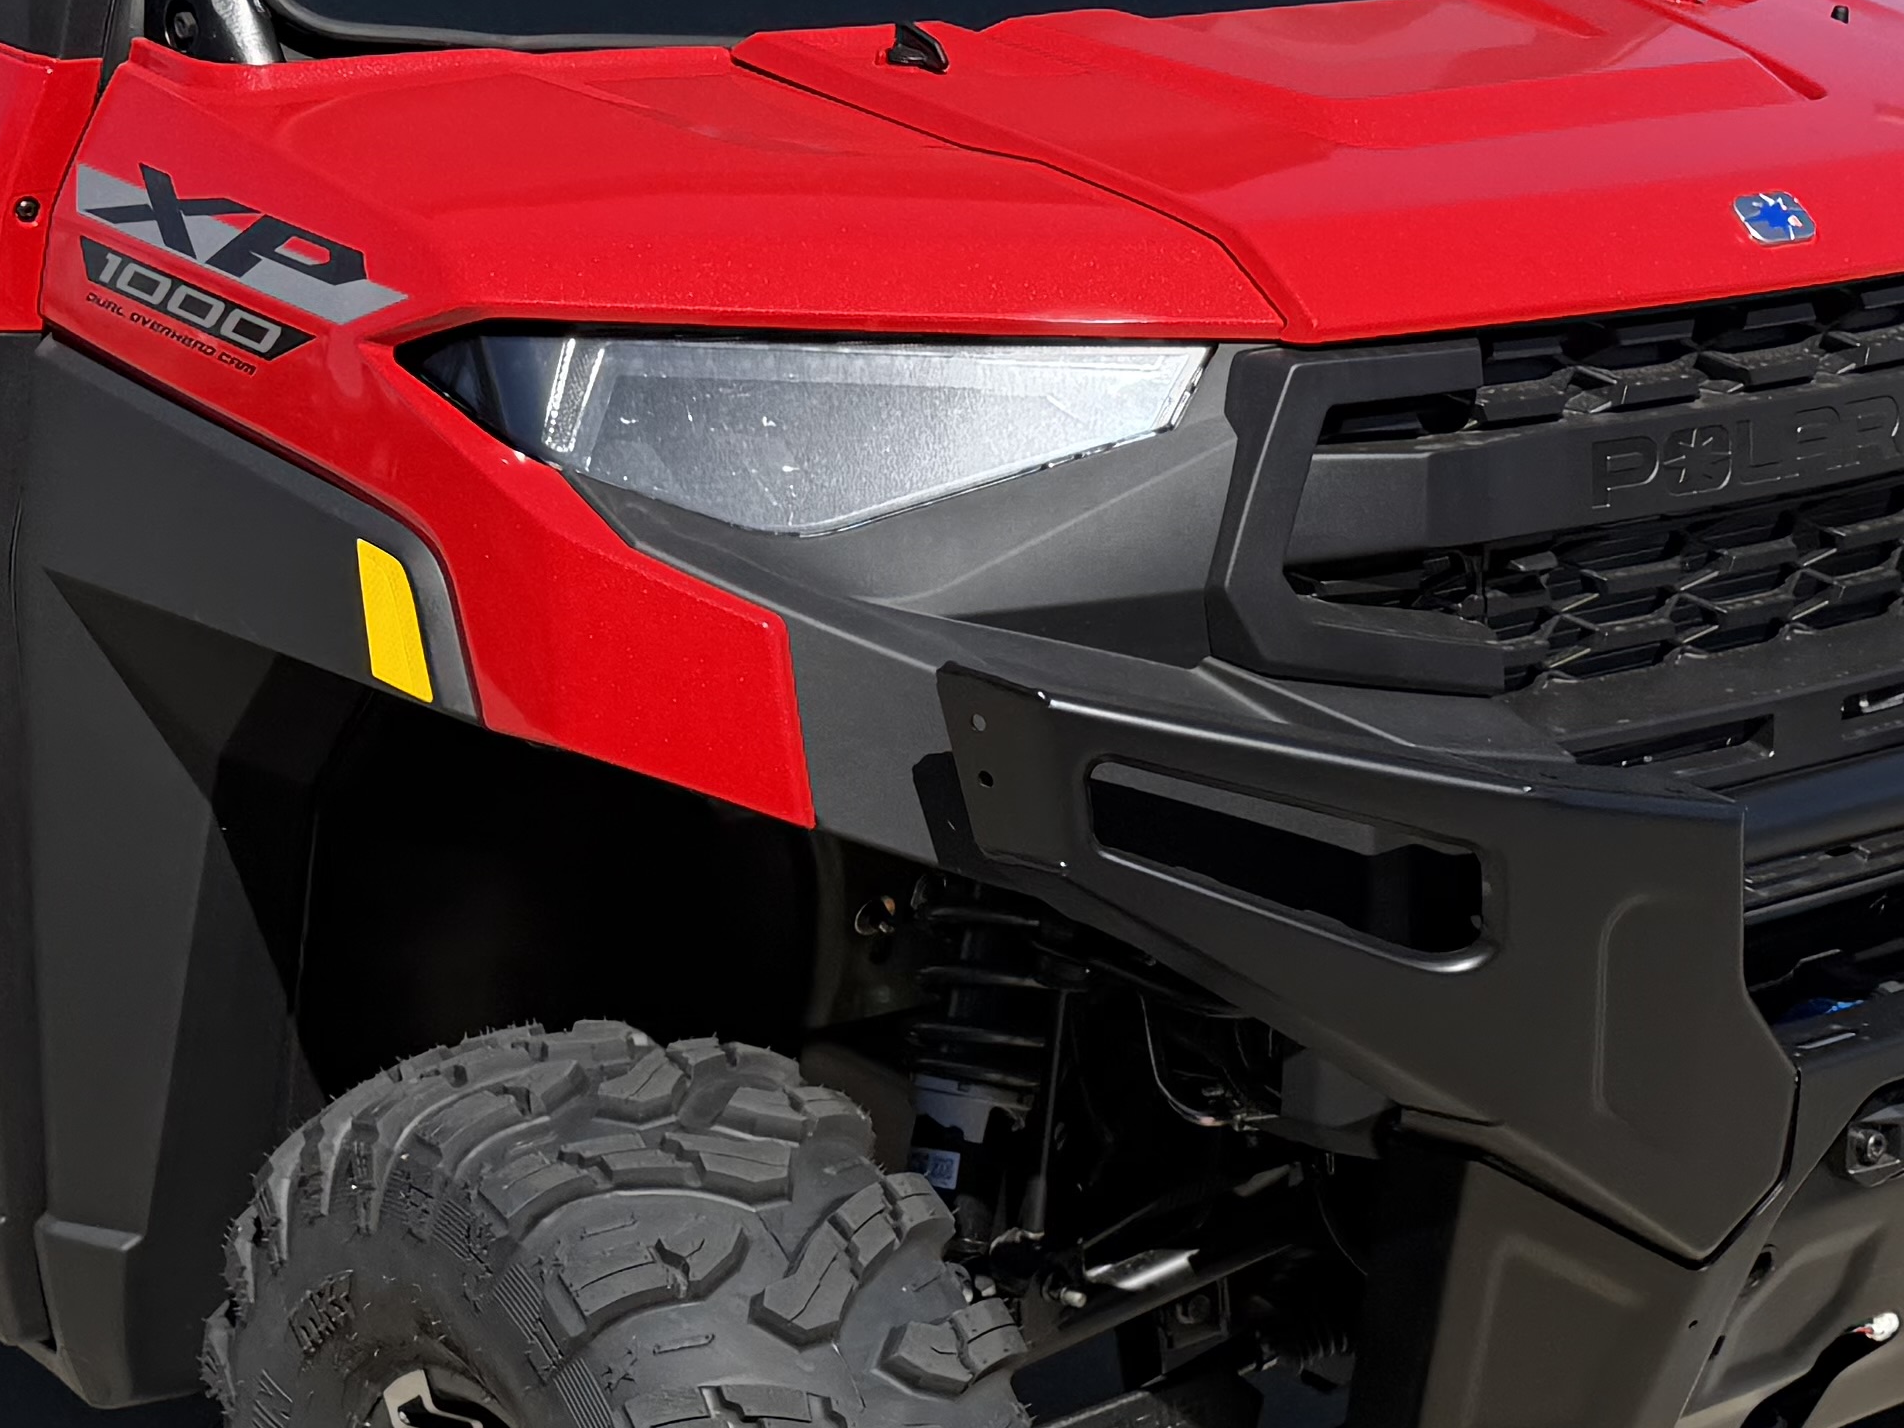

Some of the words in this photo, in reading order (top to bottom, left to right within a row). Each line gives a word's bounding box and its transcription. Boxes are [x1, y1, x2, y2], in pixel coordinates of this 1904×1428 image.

[83, 162, 367, 286] XP
[97, 252, 282, 354] 1000
[217, 351, 258, 378] CAM
